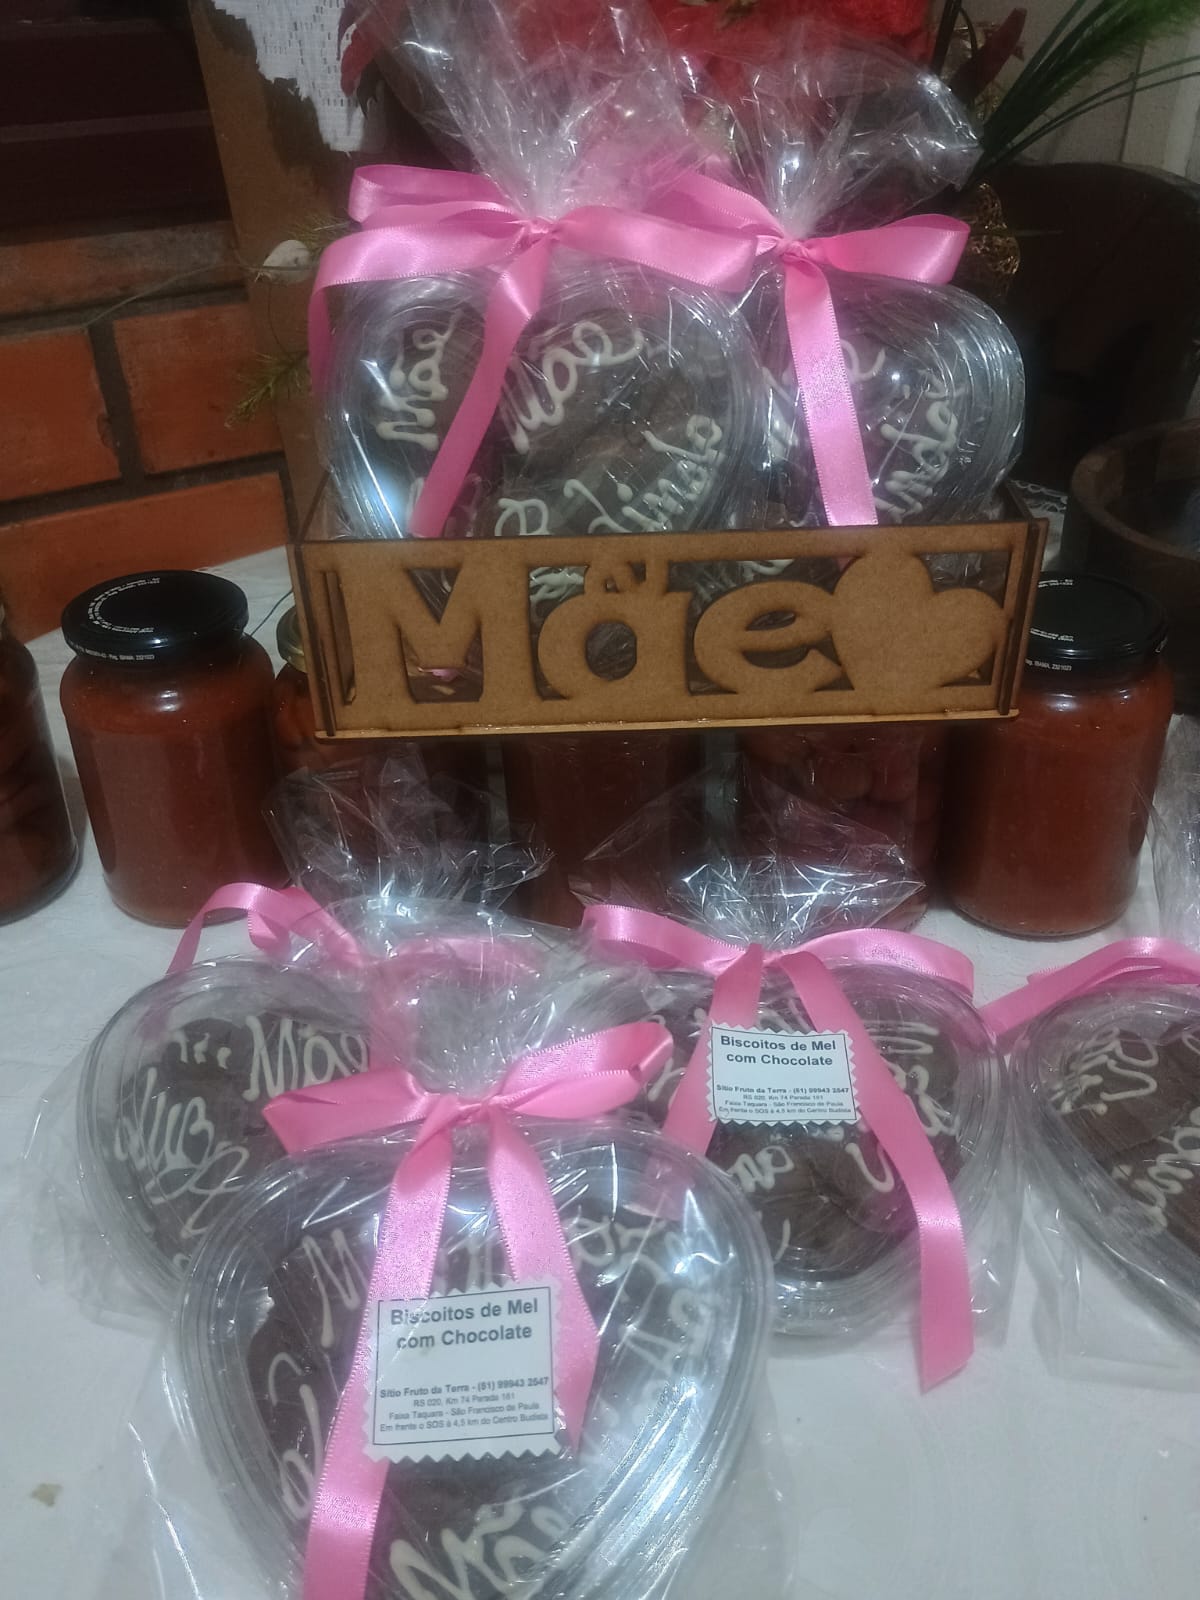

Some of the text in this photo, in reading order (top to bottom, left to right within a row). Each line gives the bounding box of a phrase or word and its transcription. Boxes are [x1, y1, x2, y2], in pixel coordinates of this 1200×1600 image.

[342, 556, 850, 702] Mãe
[721, 1035, 835, 1050] Biscoitos de Mel
[727, 1053, 832, 1066] com Chocolate
[735, 1085, 754, 1093] Fruto
[391, 1298, 538, 1325] Biscoitos de Mel
[397, 1325, 532, 1349] com Chocolate
[404, 1385, 428, 1397] Fruto
[431, 1385, 442, 1395] da
[446, 1383, 469, 1393] Terra
[472, 1393, 498, 1403] Parada
[413, 1410, 443, 1420] Taquara
[468, 1404, 503, 1415] Francisco
[506, 1404, 516, 1412] de
[518, 1401, 539, 1411] Paula
[380, 1423, 392, 1432] Em
[467, 1417, 479, 1426] km
[493, 1414, 518, 1424] Centro
